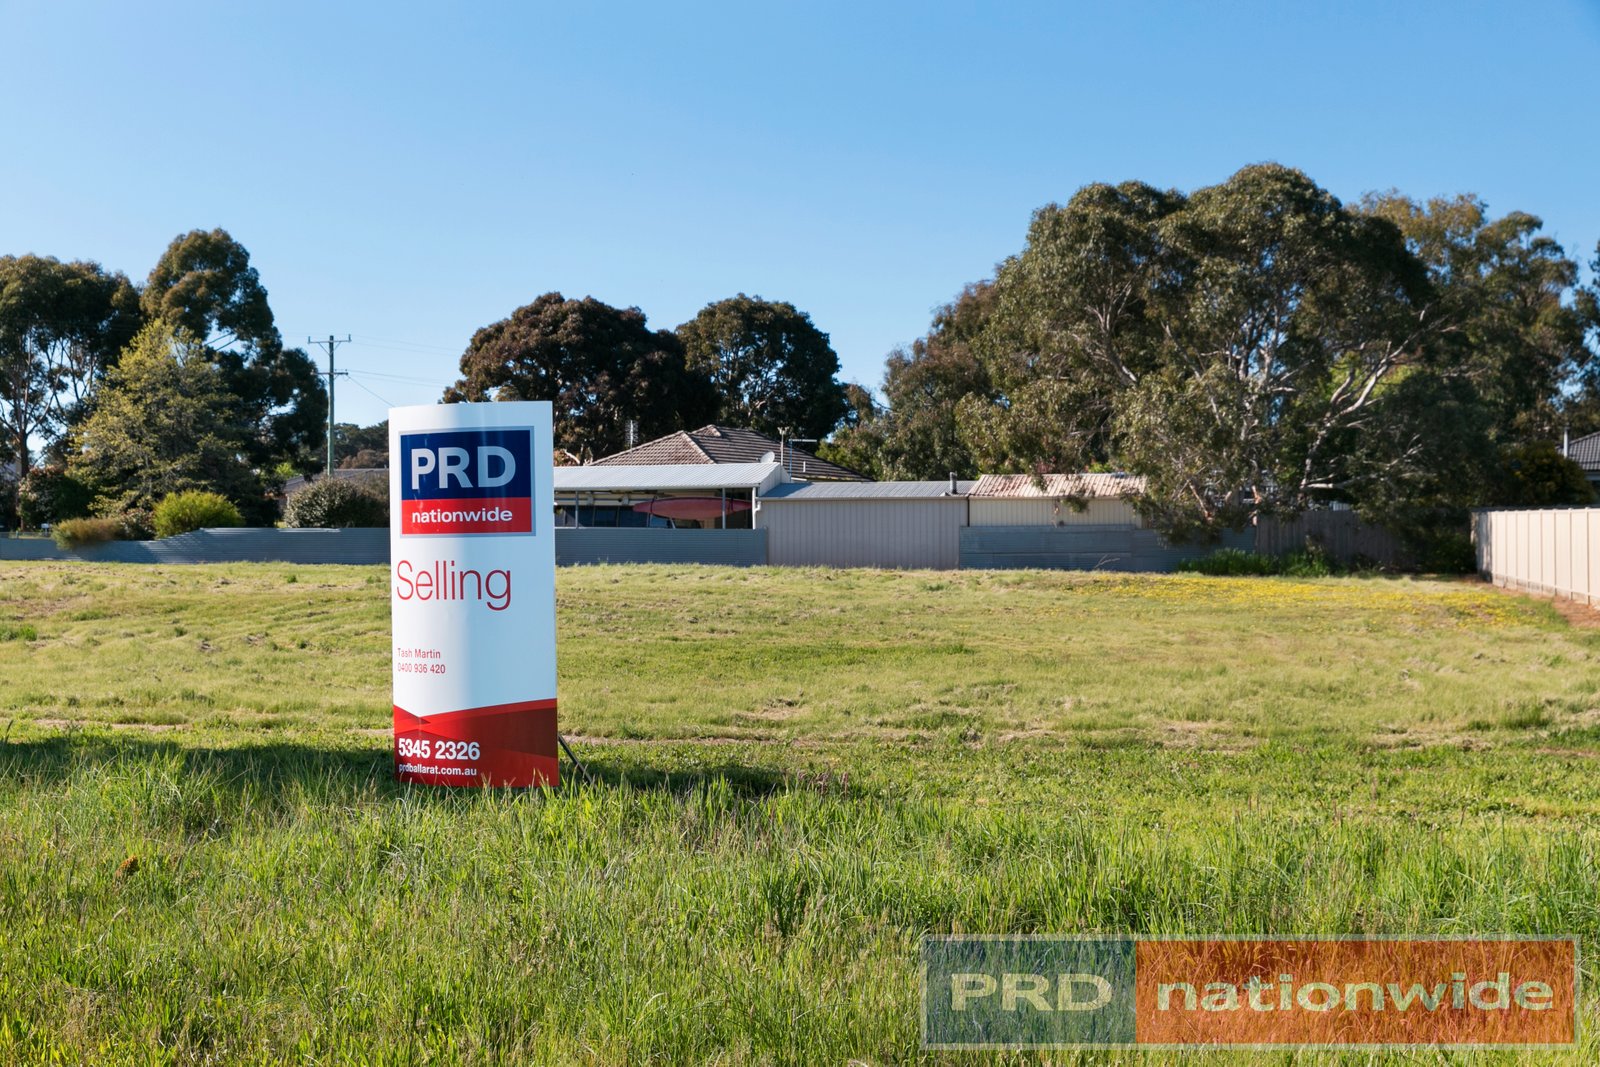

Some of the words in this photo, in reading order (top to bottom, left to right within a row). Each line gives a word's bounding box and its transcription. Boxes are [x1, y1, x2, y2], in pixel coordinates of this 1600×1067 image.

[411, 446, 516, 490] PRD
[411, 507, 513, 523] nationwide
[397, 560, 511, 611] Selling
[397, 648, 412, 658] Tash
[414, 649, 441, 659] Martin
[397, 662, 412, 673] 0400
[414, 663, 428, 673] 936
[430, 664, 446, 674] 420
[398, 738, 431, 759] 5345
[435, 741, 480, 761] 2326
[398, 763, 477, 776] prdballarat.com.au
